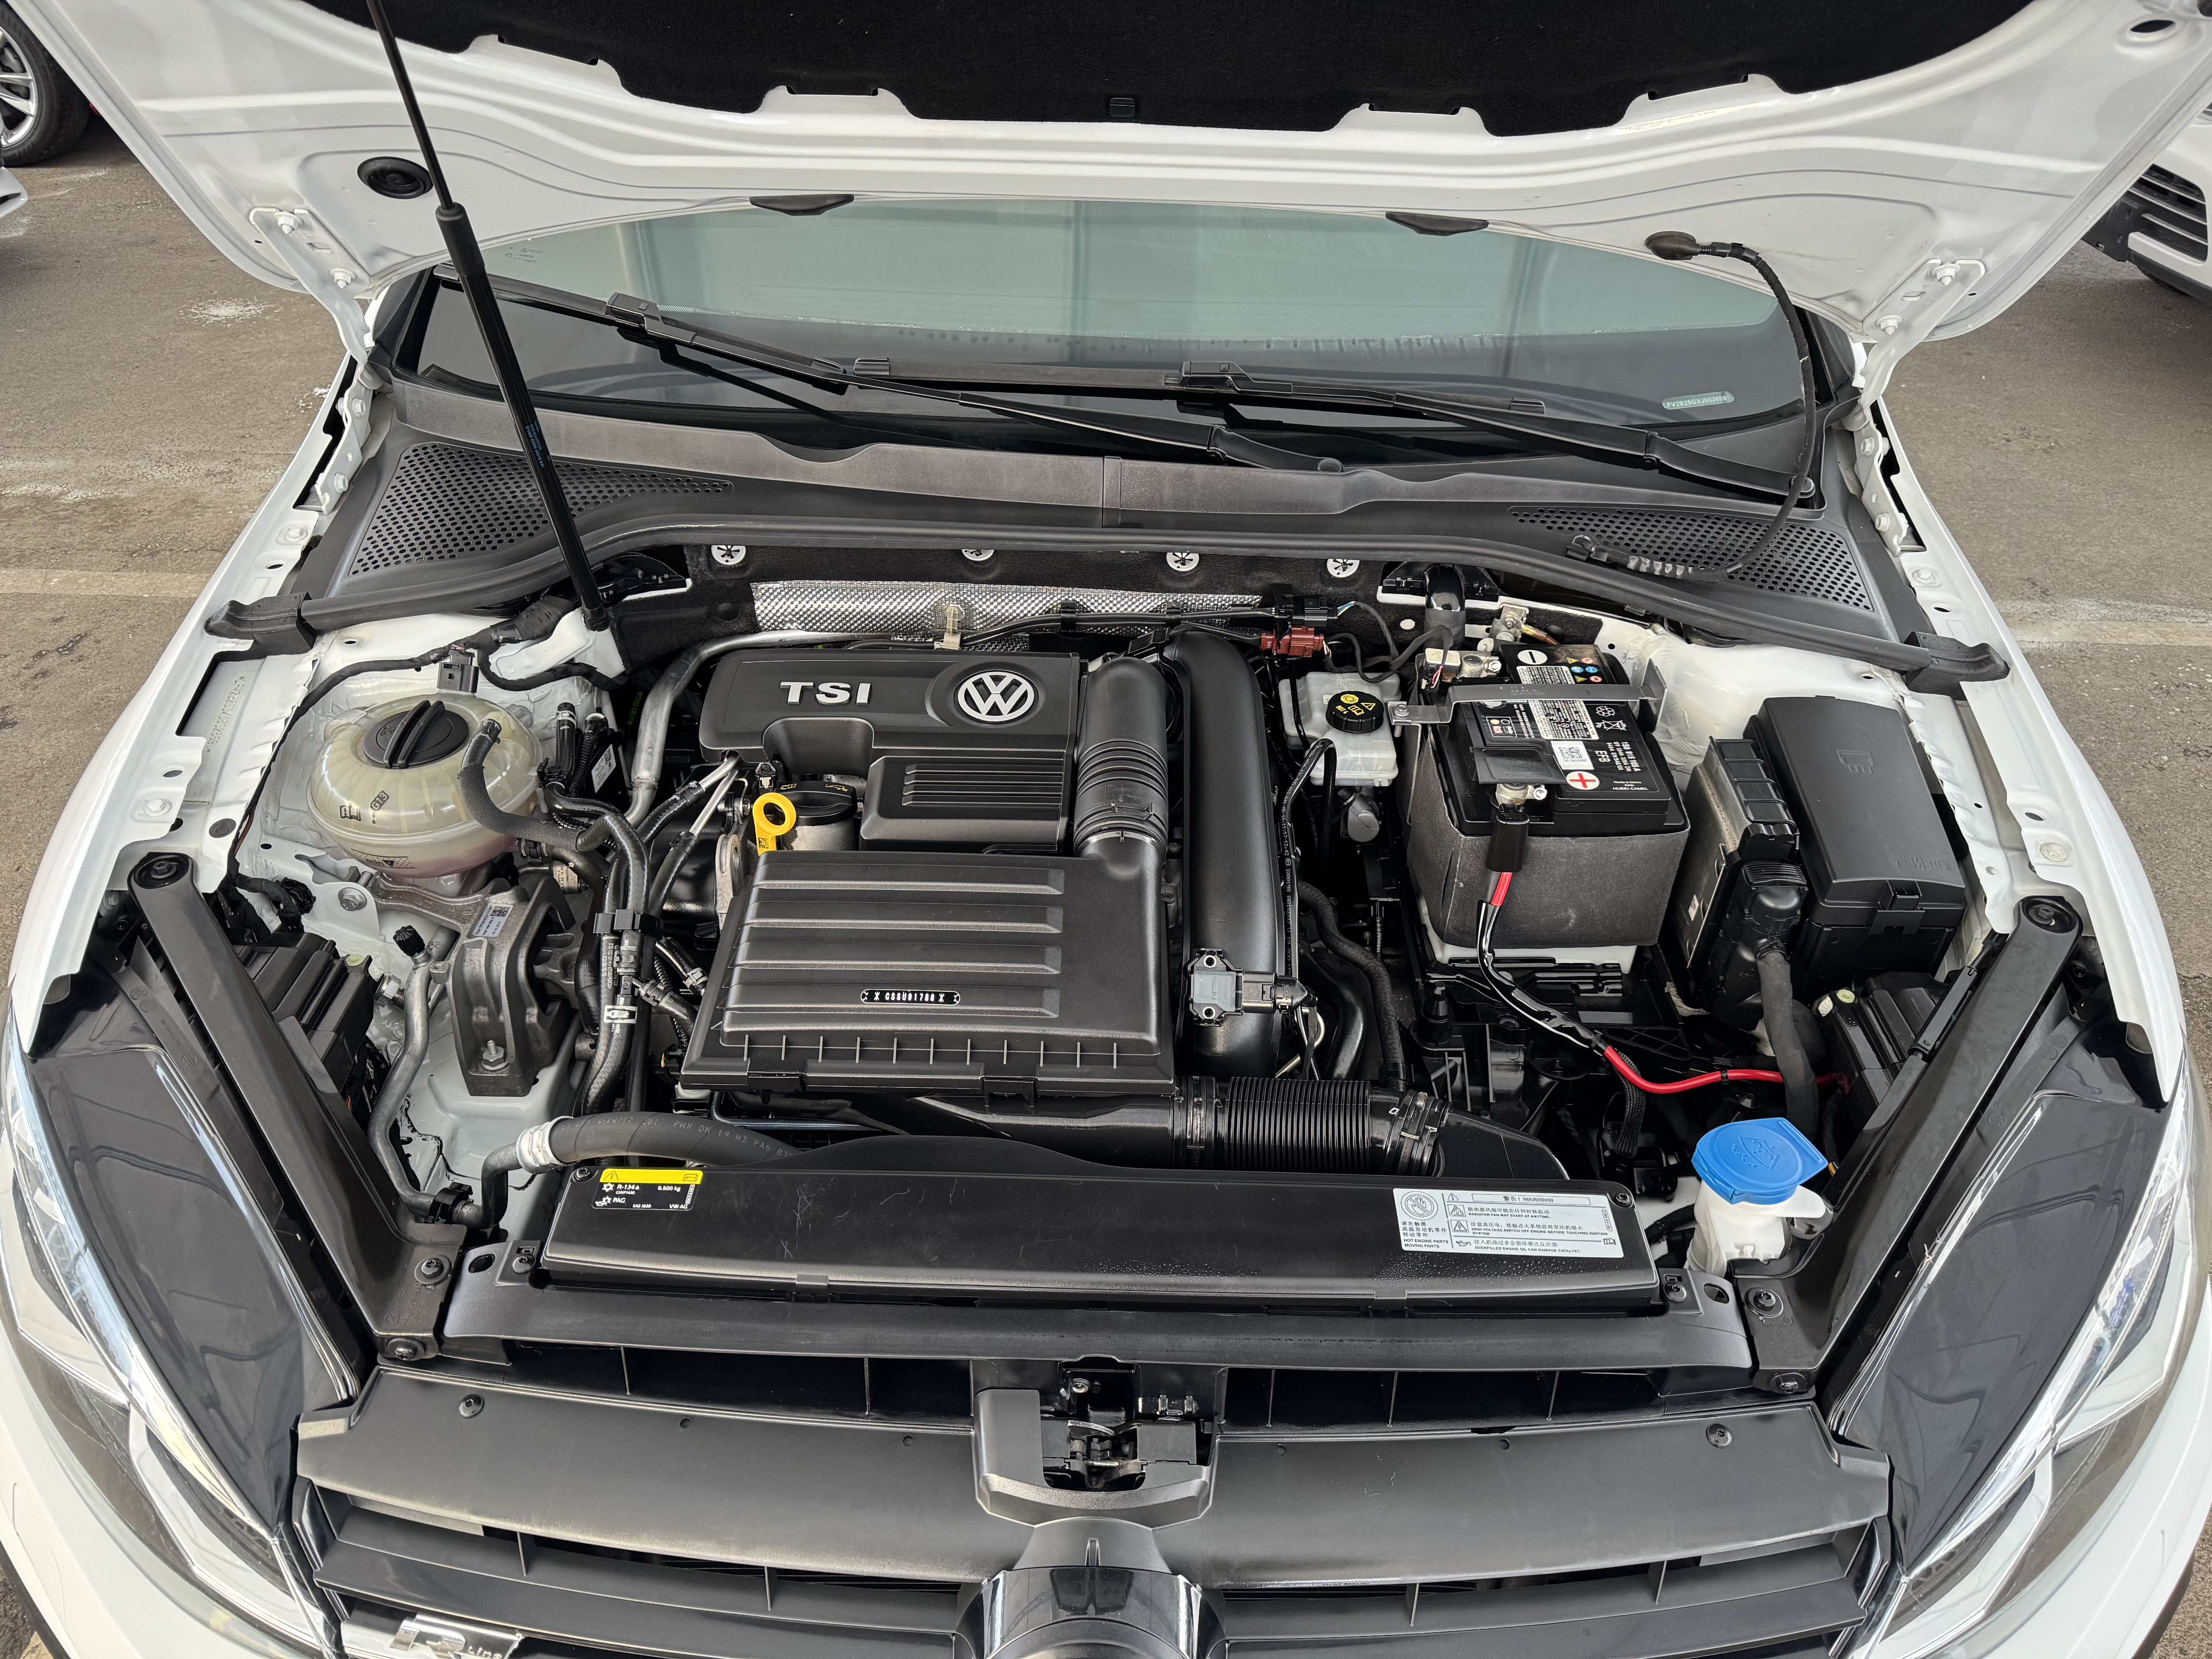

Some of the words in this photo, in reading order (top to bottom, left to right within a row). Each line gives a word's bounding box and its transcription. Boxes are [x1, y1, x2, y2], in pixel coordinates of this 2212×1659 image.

[780, 681, 872, 706] TSI
[1595, 750, 1611, 762] EFB
[372, 792, 388, 810] G13
[366, 858, 385, 866] min
[673, 1120, 693, 1130] PHX
[698, 1125, 712, 1134] DN
